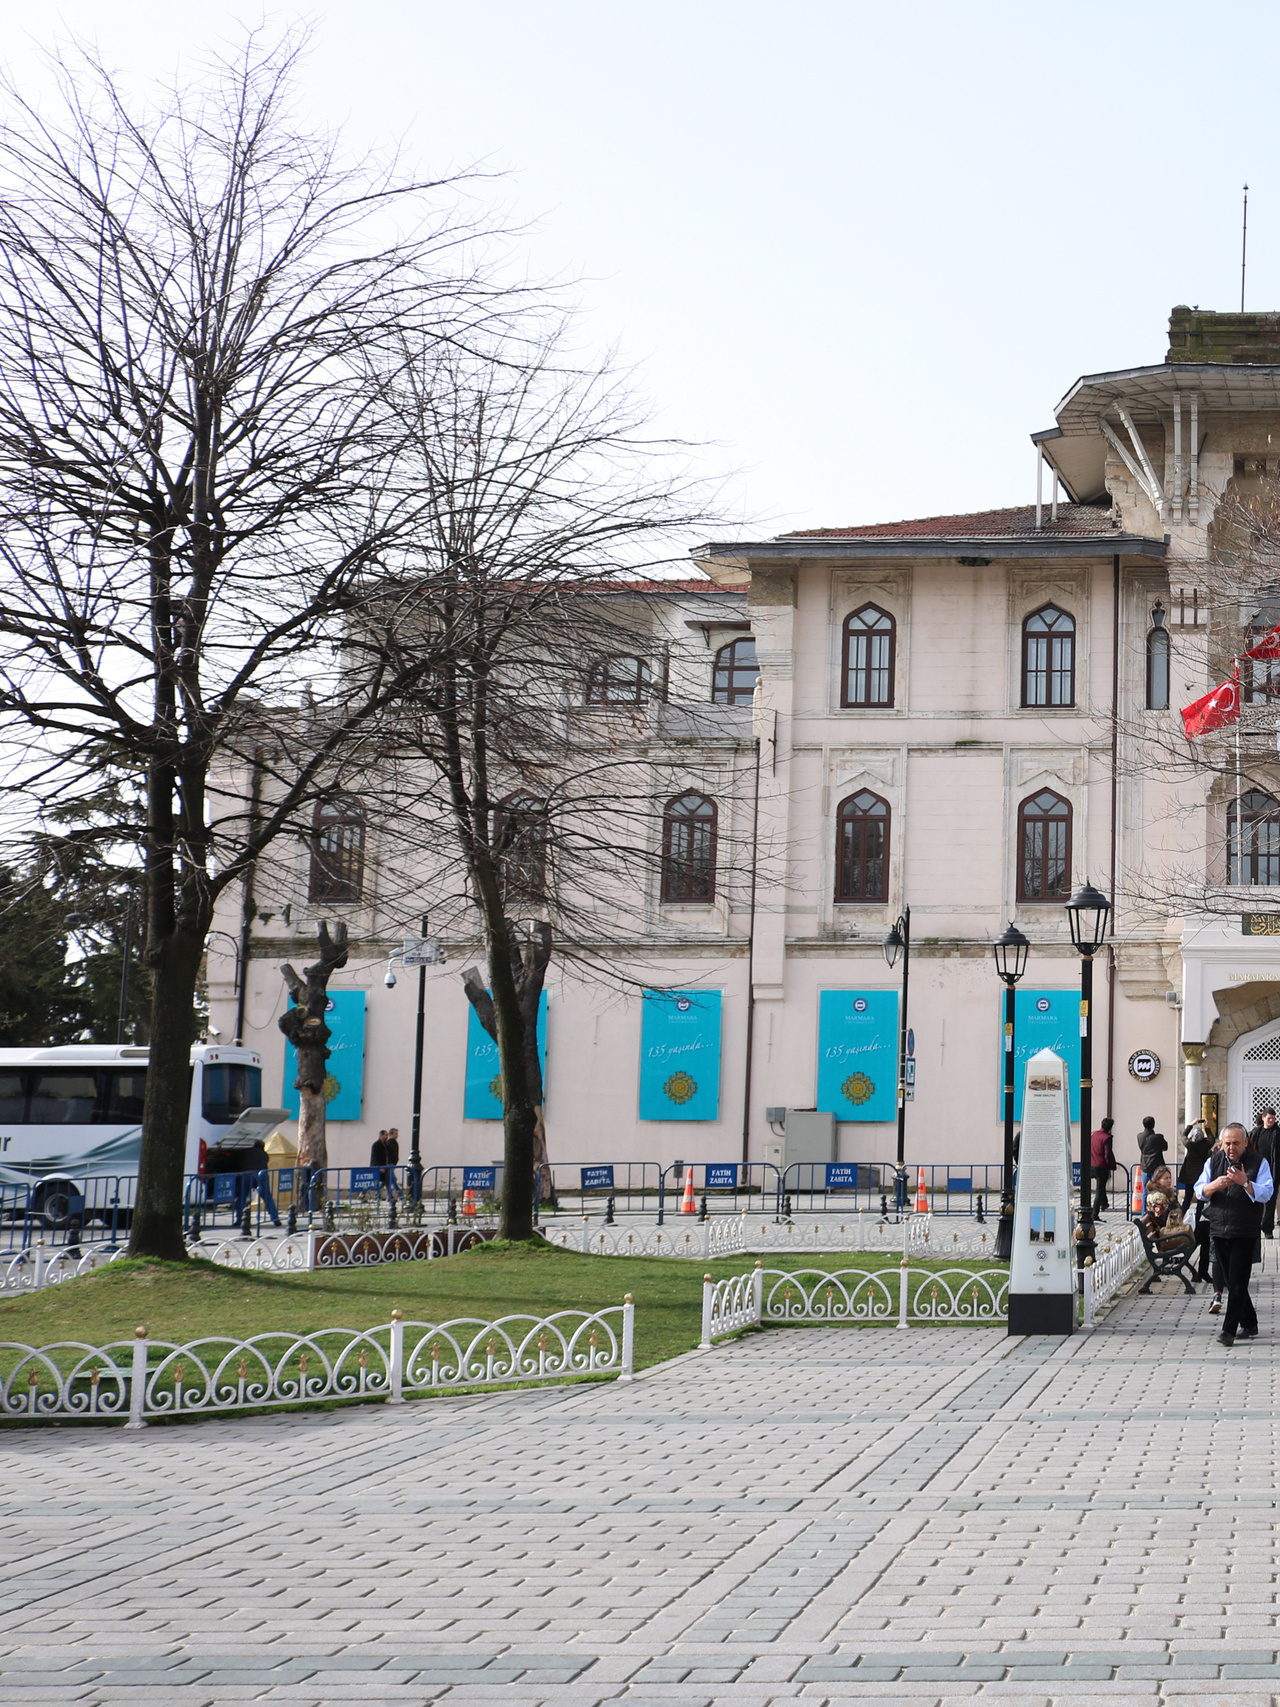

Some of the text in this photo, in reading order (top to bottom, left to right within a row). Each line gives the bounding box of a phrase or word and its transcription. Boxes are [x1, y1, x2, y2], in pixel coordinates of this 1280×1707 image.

[1229, 973, 1279, 981] MARMARA
[475, 1043, 494, 1056] 135
[648, 1043, 668, 1058] 135
[826, 1044, 845, 1058] 135
[1014, 1044, 1028, 1058] 35
